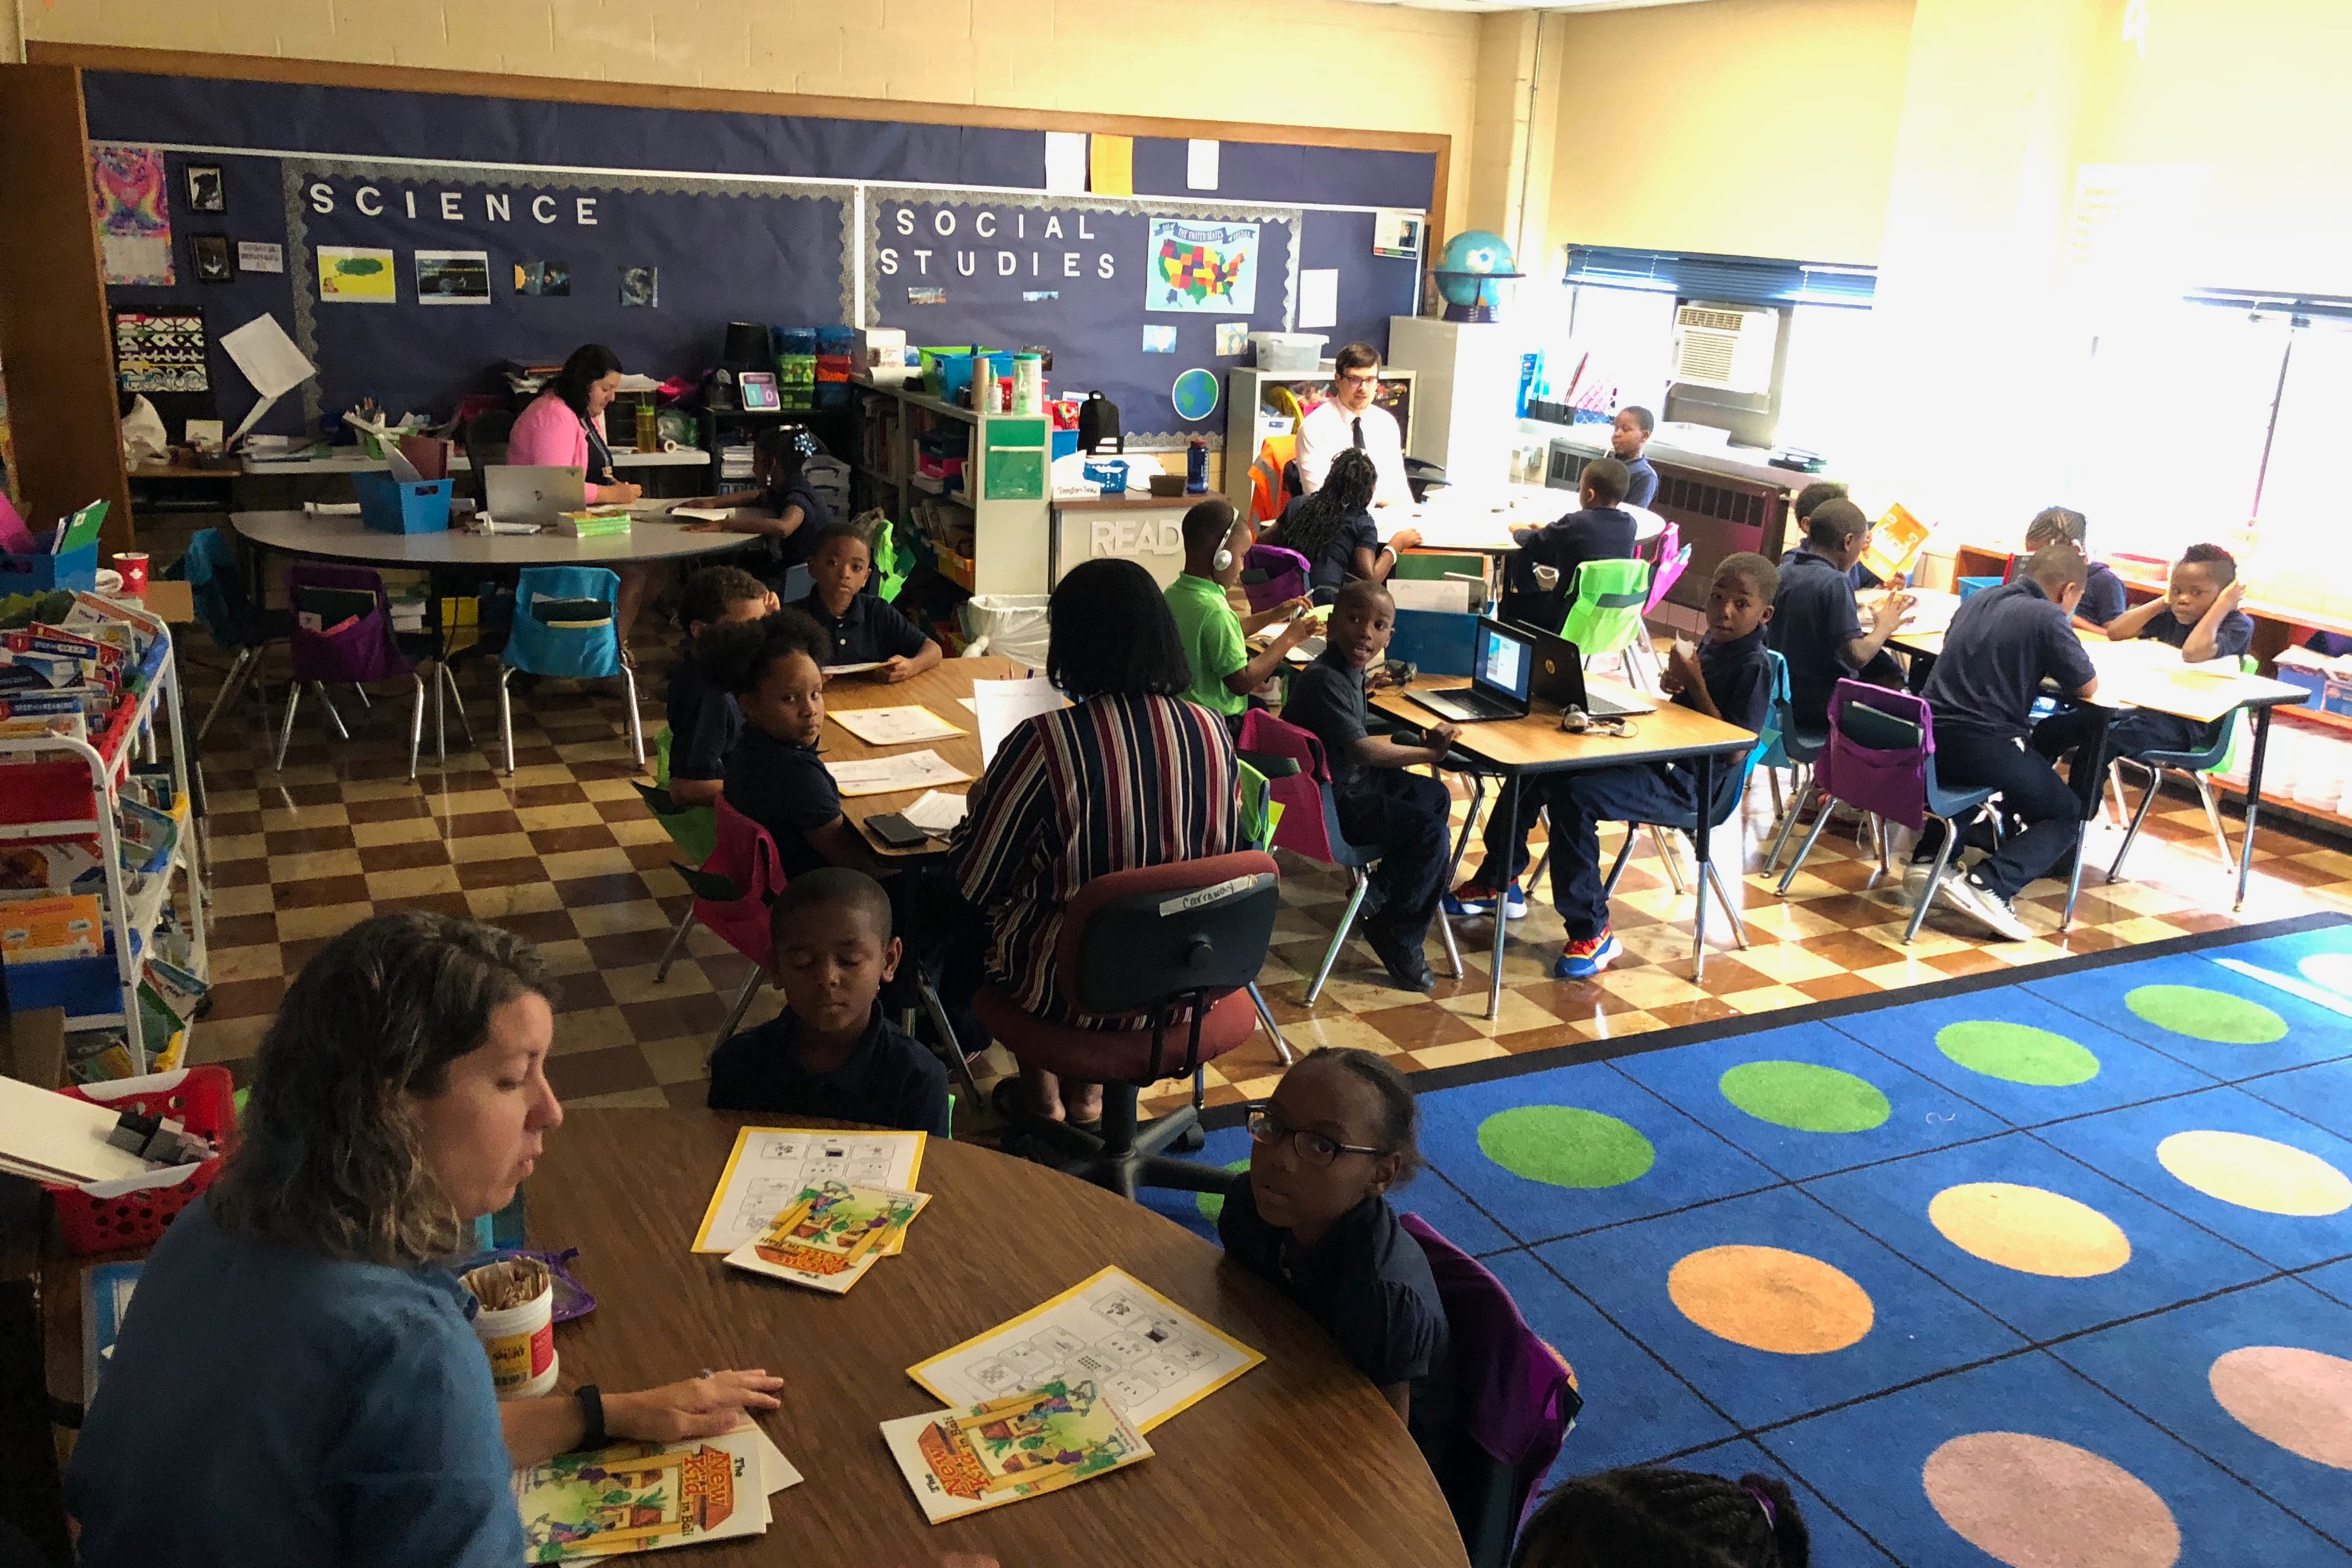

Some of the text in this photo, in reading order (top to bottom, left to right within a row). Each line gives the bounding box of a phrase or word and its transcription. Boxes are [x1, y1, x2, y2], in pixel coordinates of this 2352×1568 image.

[310, 183, 598, 225] SCIENCE
[897, 208, 1094, 240] SOCIAL
[880, 249, 1114, 279] STUDIES
[1090, 520, 1183, 556] READ
[1182, 881, 1234, 909] Carraway
[708, 1451, 731, 1506] New
[734, 1457, 745, 1477] The
[925, 1474, 940, 1493] The
[929, 1448, 969, 1496] New
[954, 1452, 992, 1492] Kid
[681, 1457, 706, 1536] Kid in Bali
